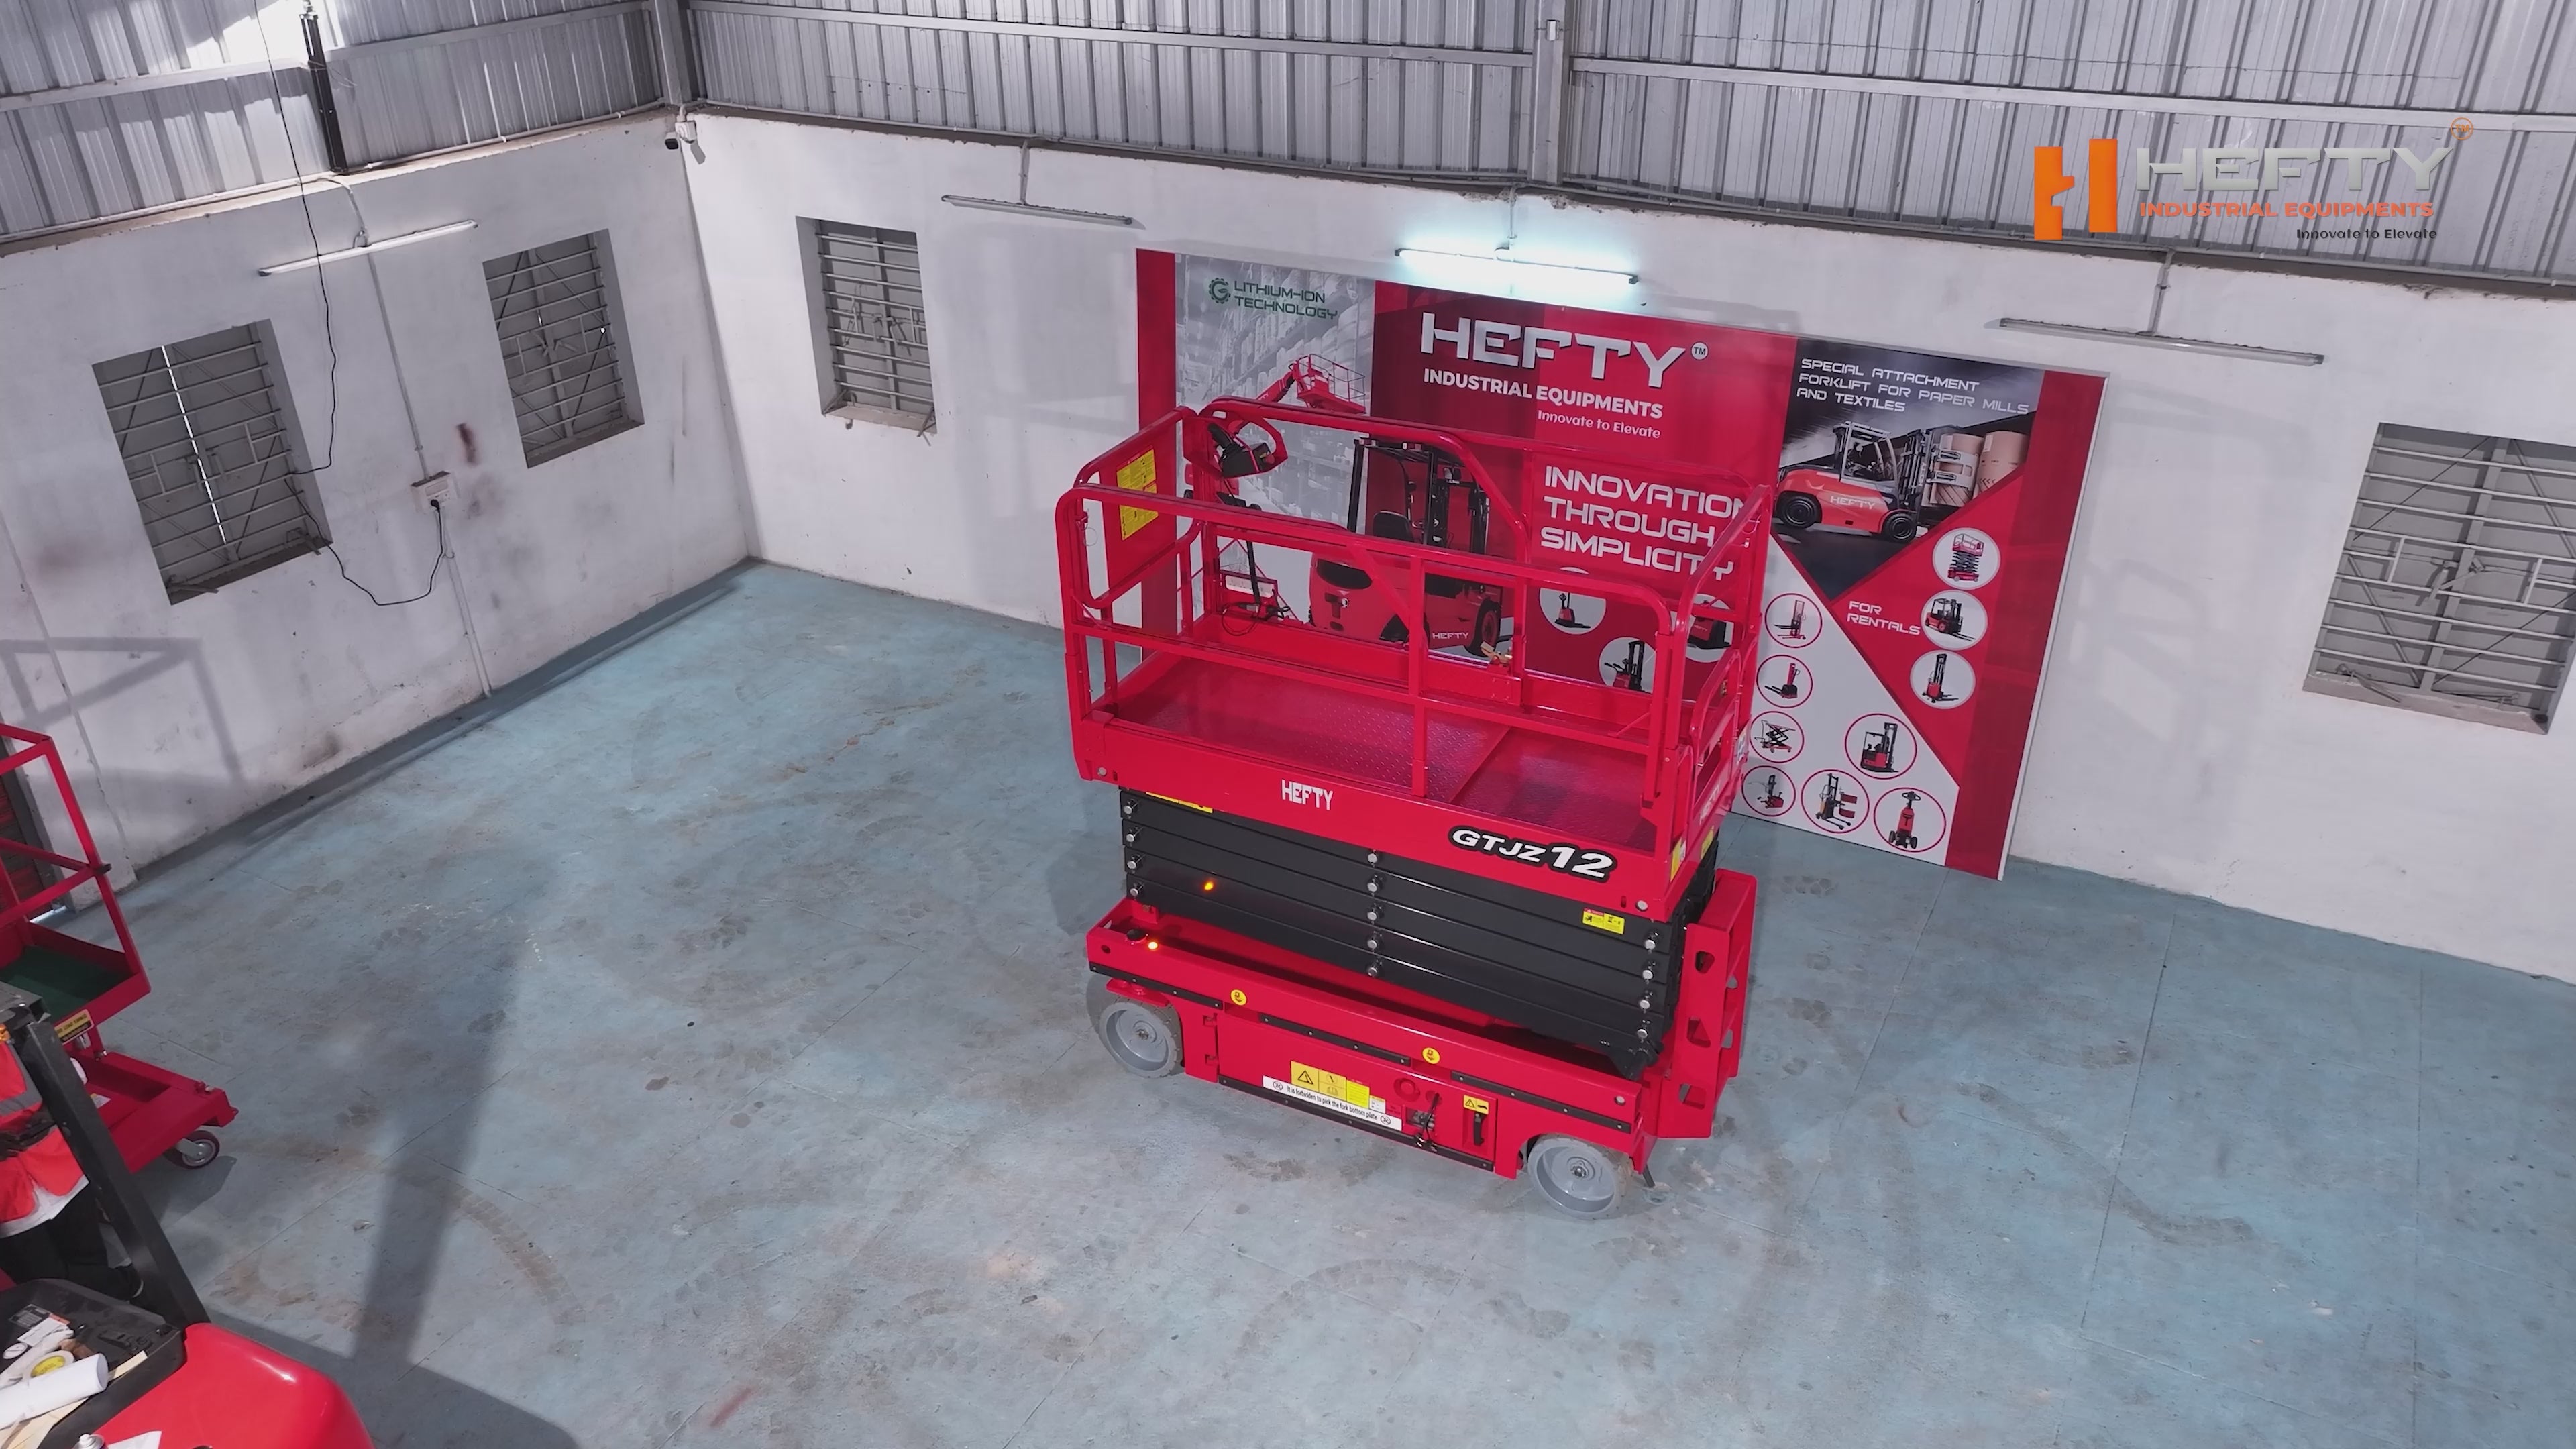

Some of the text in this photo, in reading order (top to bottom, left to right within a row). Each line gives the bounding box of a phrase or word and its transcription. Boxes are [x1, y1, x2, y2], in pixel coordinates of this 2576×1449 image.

[1234, 280, 1325, 303] LITHIUM-ION
[1234, 296, 1338, 320] TECHNOLOGY
[1421, 312, 1686, 388] HEFTY
[1801, 358, 1980, 392] SPECIAL ATTACHMENT
[1424, 368, 1663, 419] INDUSTRIAL EQUIPMENTS
[1796, 387, 1906, 412] AND TEXTILES
[1799, 373, 2029, 415] FORKLIFT FOR PAPER MILLS
[1538, 409, 1661, 439] Innovate to Elevate
[1829, 496, 1876, 510] HEFTY
[1544, 496, 1715, 547] THROUGH
[1848, 600, 1882, 615] FOR
[1432, 632, 1470, 640] HEFTY
[1847, 612, 1921, 635] RENTALS
[1281, 779, 1334, 811] HEFTY
[1295, 1088, 1316, 1101] forbidden
[1322, 1097, 1331, 1106] pick
[1349, 1105, 1366, 1116] bottom
[1366, 1111, 1377, 1121] plate
